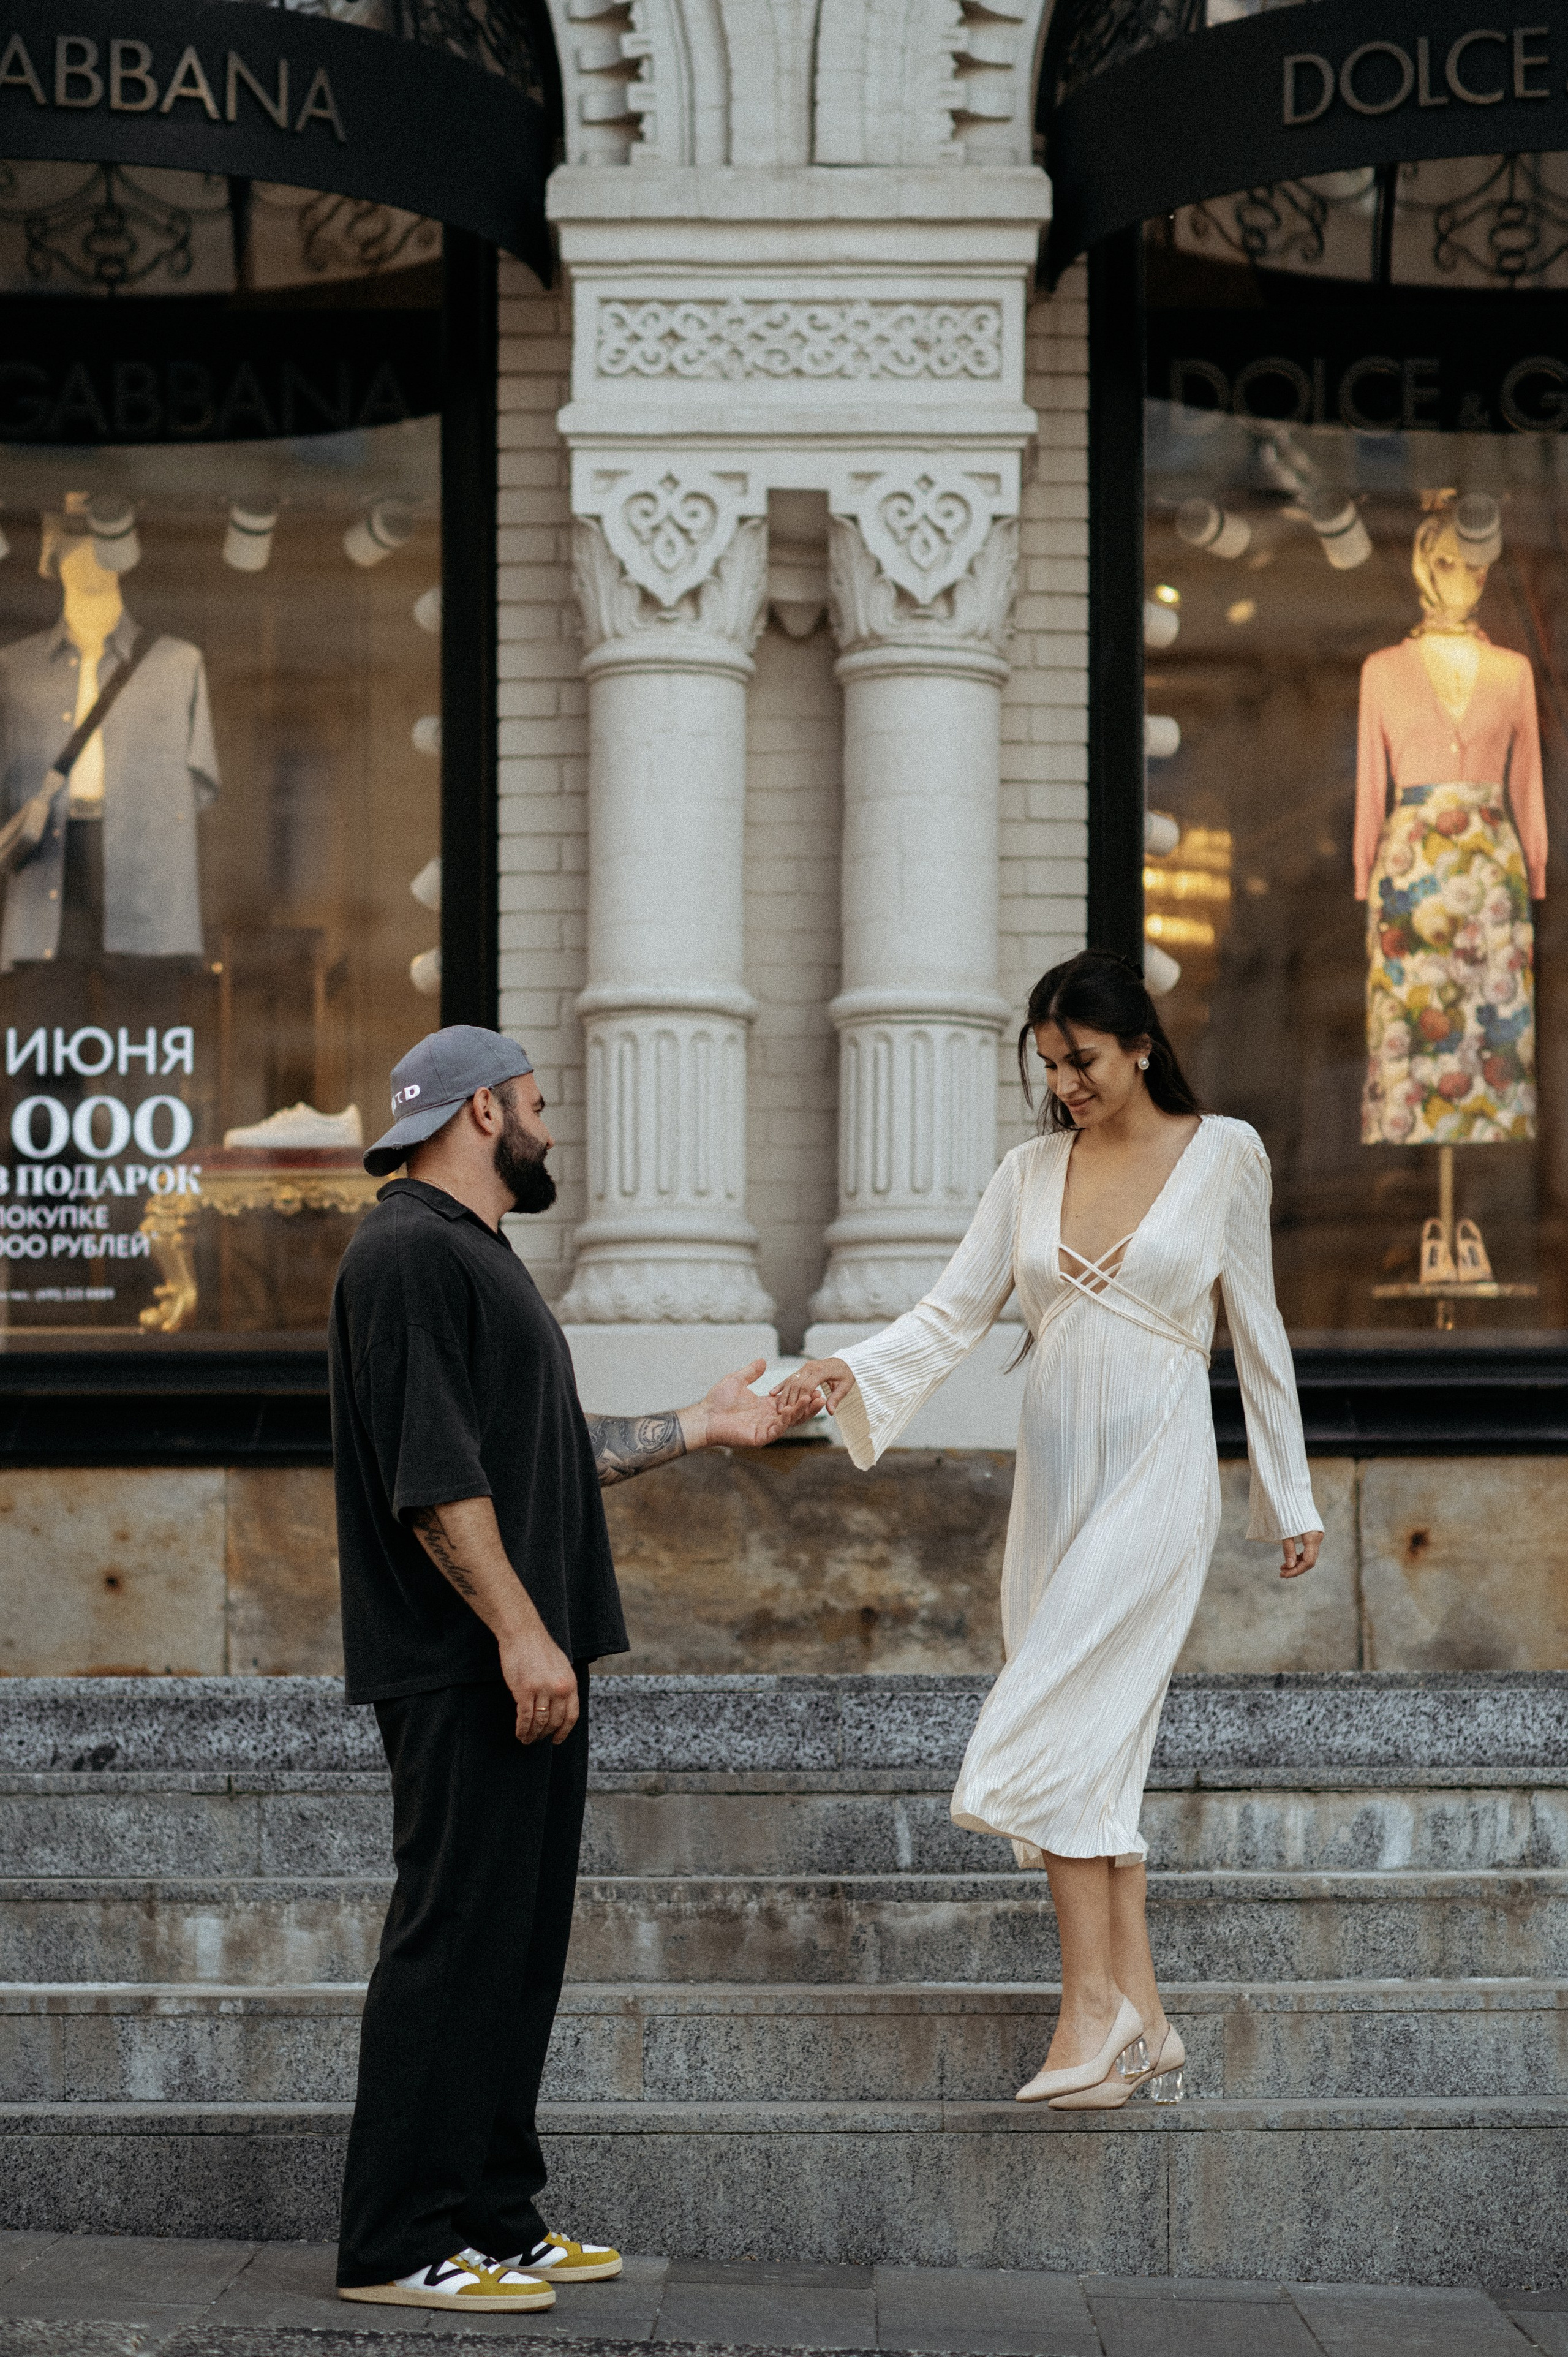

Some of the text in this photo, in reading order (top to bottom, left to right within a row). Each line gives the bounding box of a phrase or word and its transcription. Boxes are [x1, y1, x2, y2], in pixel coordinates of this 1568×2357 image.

[0, 34, 347, 143] ABBANA
[1282, 26, 1551, 125] DOLCE
[6, 1026, 194, 1076] ИЮНЯ
[10, 1095, 194, 1159] 000
[16, 1165, 202, 1200] ПОДАРОК
[0, 1234, 48, 1259] 00
